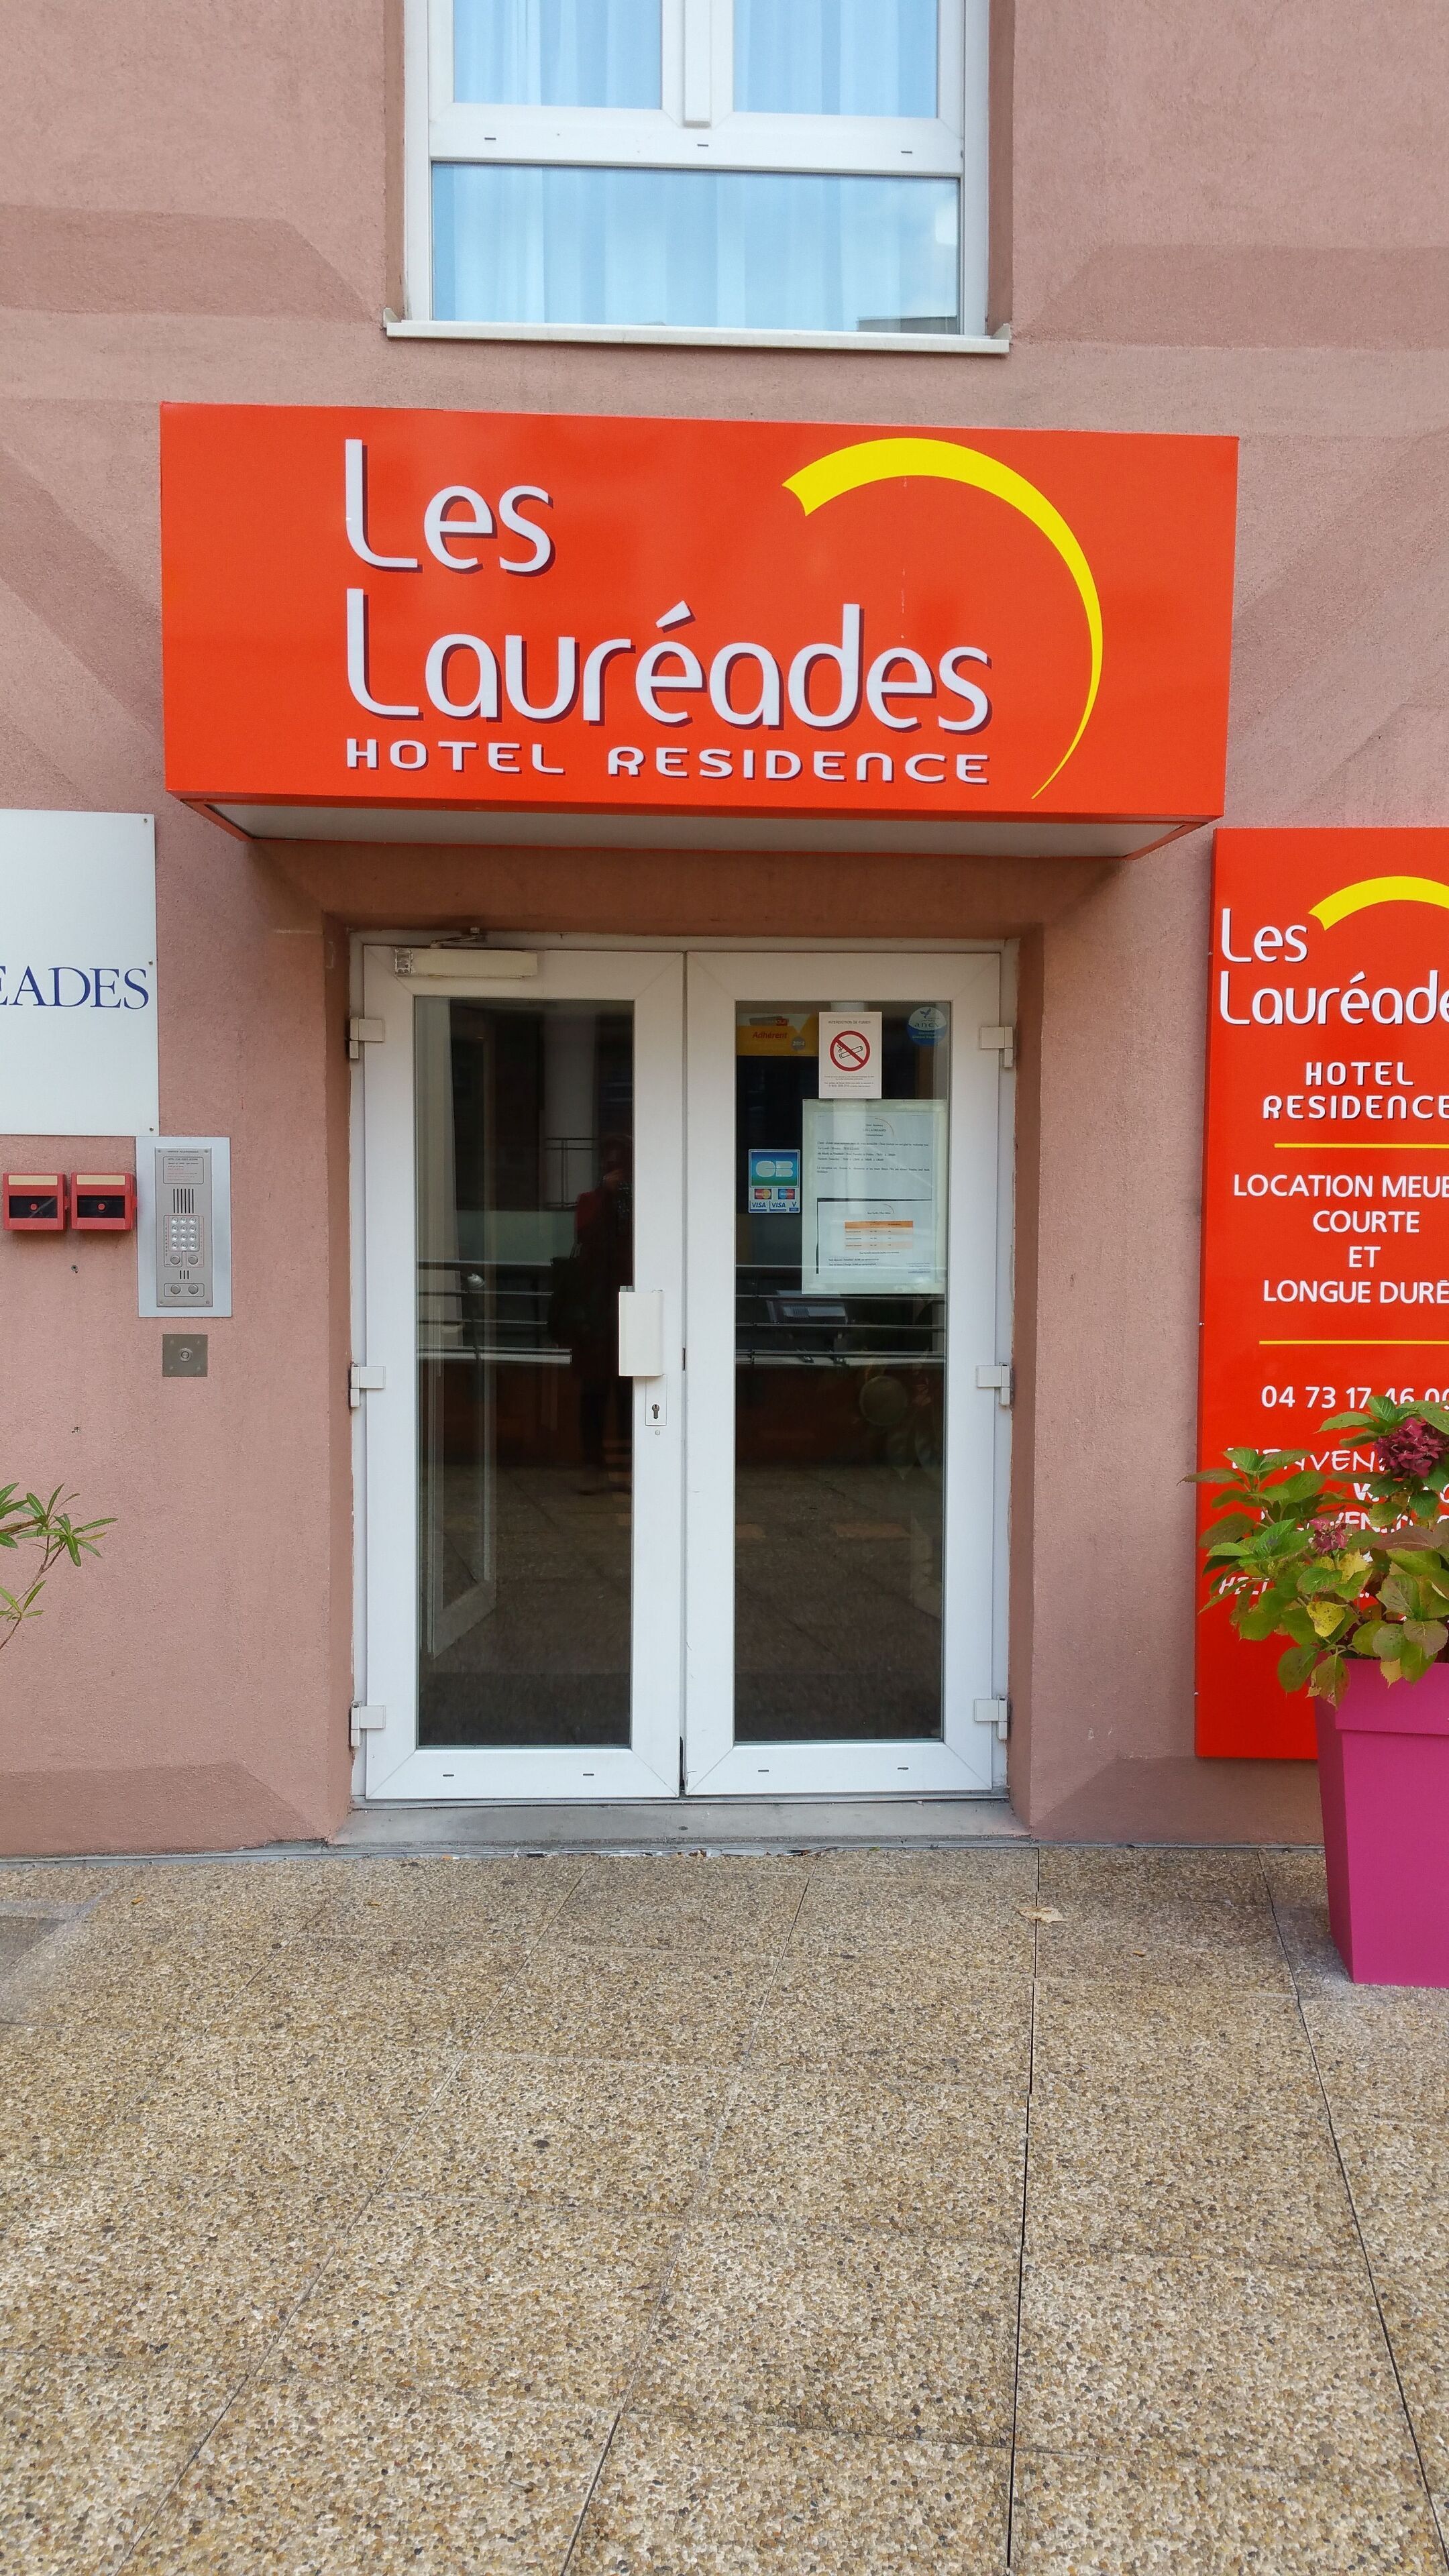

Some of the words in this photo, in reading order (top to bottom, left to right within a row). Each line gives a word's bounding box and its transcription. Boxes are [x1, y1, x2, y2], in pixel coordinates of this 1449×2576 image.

[345, 439, 552, 574] Les
[346, 588, 989, 732] Lauréades
[347, 738, 564, 774] HOTEL
[608, 746, 989, 784] RESIDENCE
[1222, 908, 1308, 963] Les
[0, 965, 150, 1010] ADES
[1305, 1061, 1414, 1086] HOTEL
[1234, 1174, 1374, 1198] LOCATION
[1313, 1210, 1420, 1234] COURTE
[1349, 1246, 1382, 1269] ET
[1264, 1279, 1372, 1304] LONGUE
[1261, 1385, 1295, 1408] 04
[1305, 1386, 1336, 1409] 73
[1346, 1387, 1373, 1409] 17
